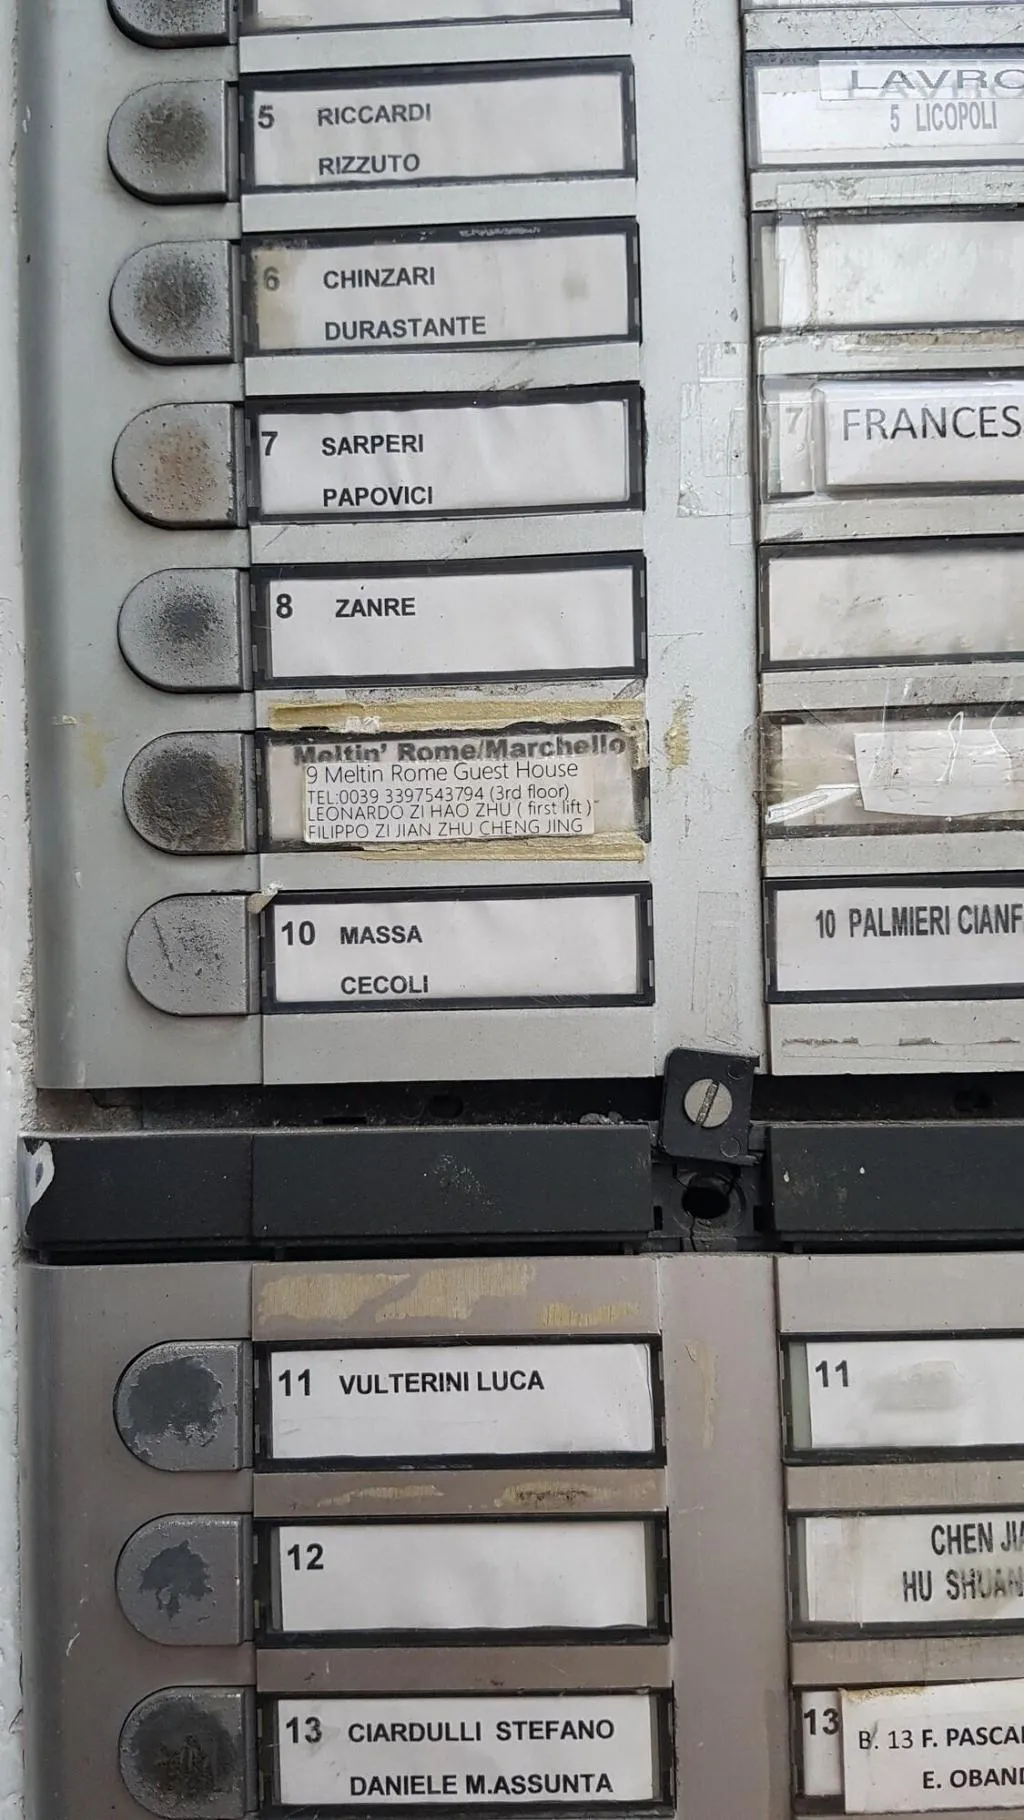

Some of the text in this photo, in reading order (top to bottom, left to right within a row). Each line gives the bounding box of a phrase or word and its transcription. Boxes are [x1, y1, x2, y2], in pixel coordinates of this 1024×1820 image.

[257, 103, 432, 129] 5 RICCARDI
[889, 101, 997, 133] 5 LICOPOLI
[318, 153, 421, 175] RIZZUTO
[262, 266, 436, 292] 6 CHINZARI
[324, 315, 487, 341] DURASTANTE
[785, 407, 804, 435] 7
[260, 431, 424, 457] 7 SARPERI
[322, 485, 433, 508] PAPOVICI
[275, 593, 417, 619] 8 ZANRE
[306, 760, 578, 784] 9 Meltin Rome Guest House
[308, 783, 569, 805] TEL:0039 3397543794 (3rd floor)
[308, 805, 404, 822] LEONARDO
[410, 804, 424, 820] ZI
[430, 803, 469, 818] HAO
[476, 802, 511, 817] ZHU
[528, 801, 557, 816] first
[562, 800, 582, 815] lift
[308, 817, 583, 839] FILIPPO ZI JIAN ZHU CHENG JING
[281, 920, 423, 946] 10 MASSA
[815, 908, 836, 939] 10
[849, 905, 950, 938] PALMIERI
[340, 975, 429, 995] CECOLI
[278, 1368, 545, 1397] 11 VULTERINI LUCA
[815, 1359, 849, 1388] 11
[931, 1520, 993, 1556] CHEN
[287, 1543, 324, 1571] 12
[902, 1570, 933, 1602] HU
[285, 1716, 615, 1744] 13 CIARDULLI STEFANO
[803, 1708, 839, 1736] 13
[858, 1725, 1024, 1750] B. 13 F. PASCA
[350, 1774, 458, 1797] DANIELE
[922, 1771, 942, 1789] E.
